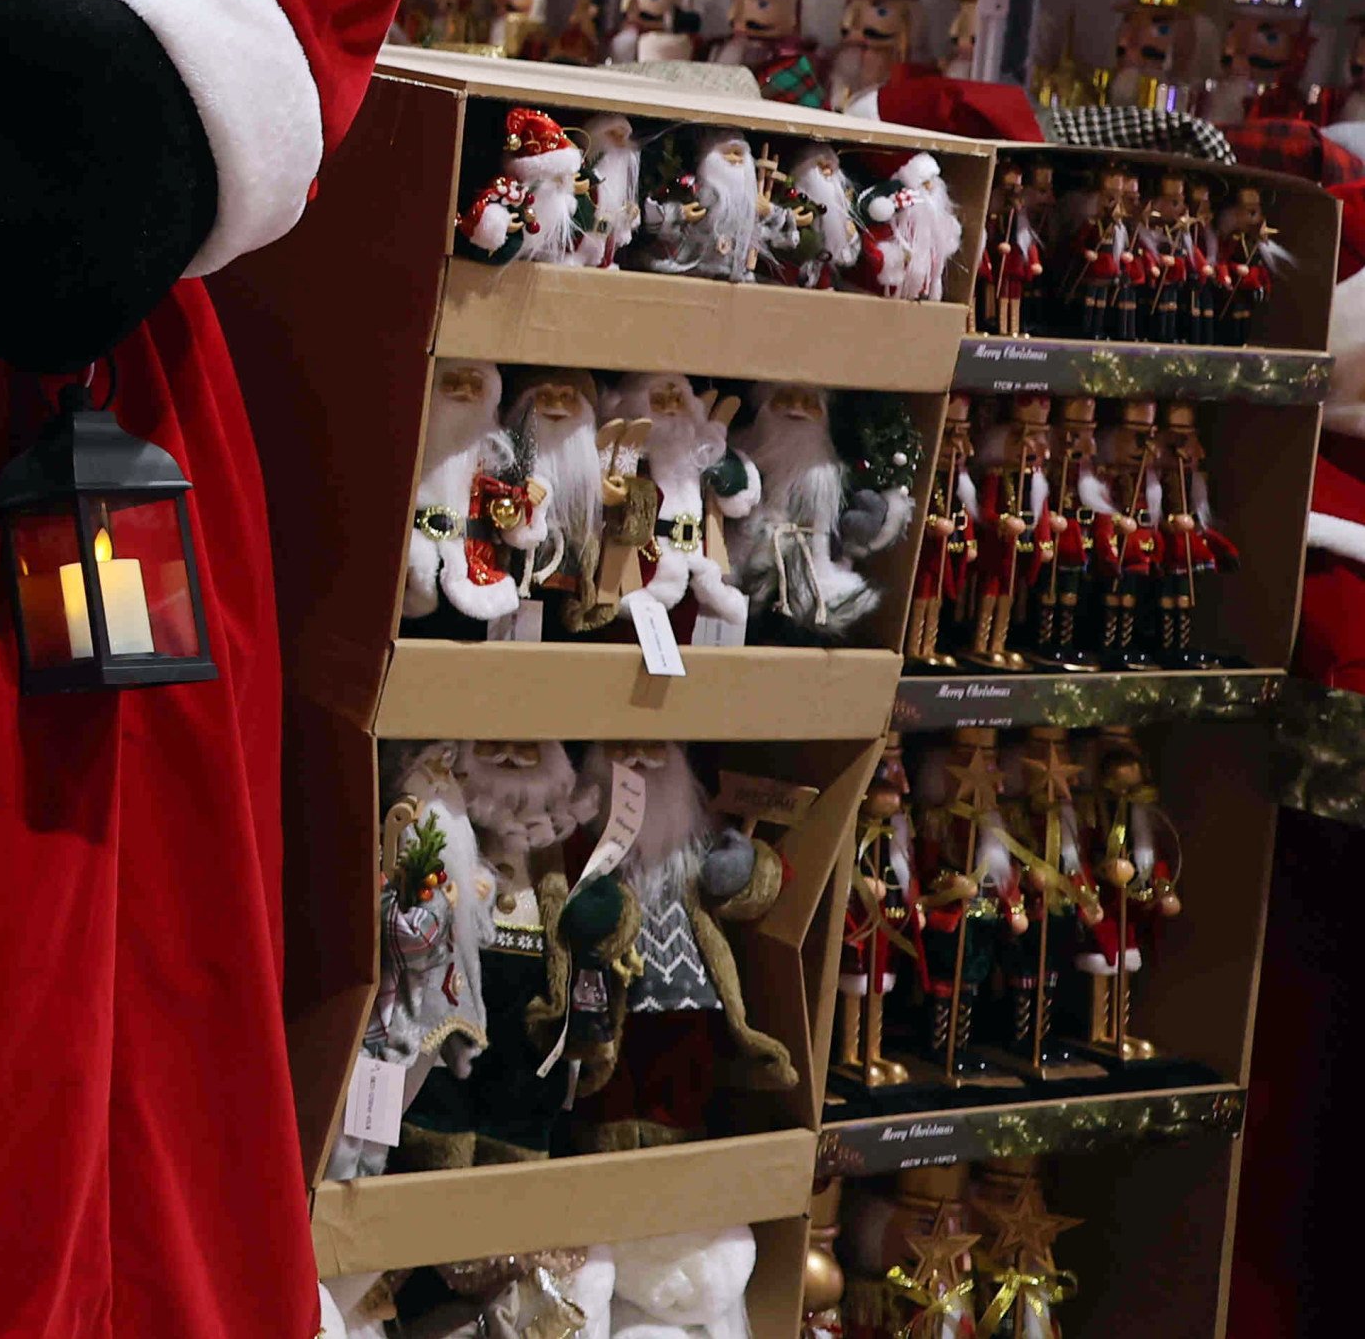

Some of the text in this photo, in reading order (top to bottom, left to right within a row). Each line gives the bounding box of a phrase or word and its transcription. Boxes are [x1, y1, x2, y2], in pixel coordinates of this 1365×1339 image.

[1003, 344, 1048, 361] Christmas
[966, 682, 1012, 699] Christmas
[909, 1122, 954, 1138] Christmas
